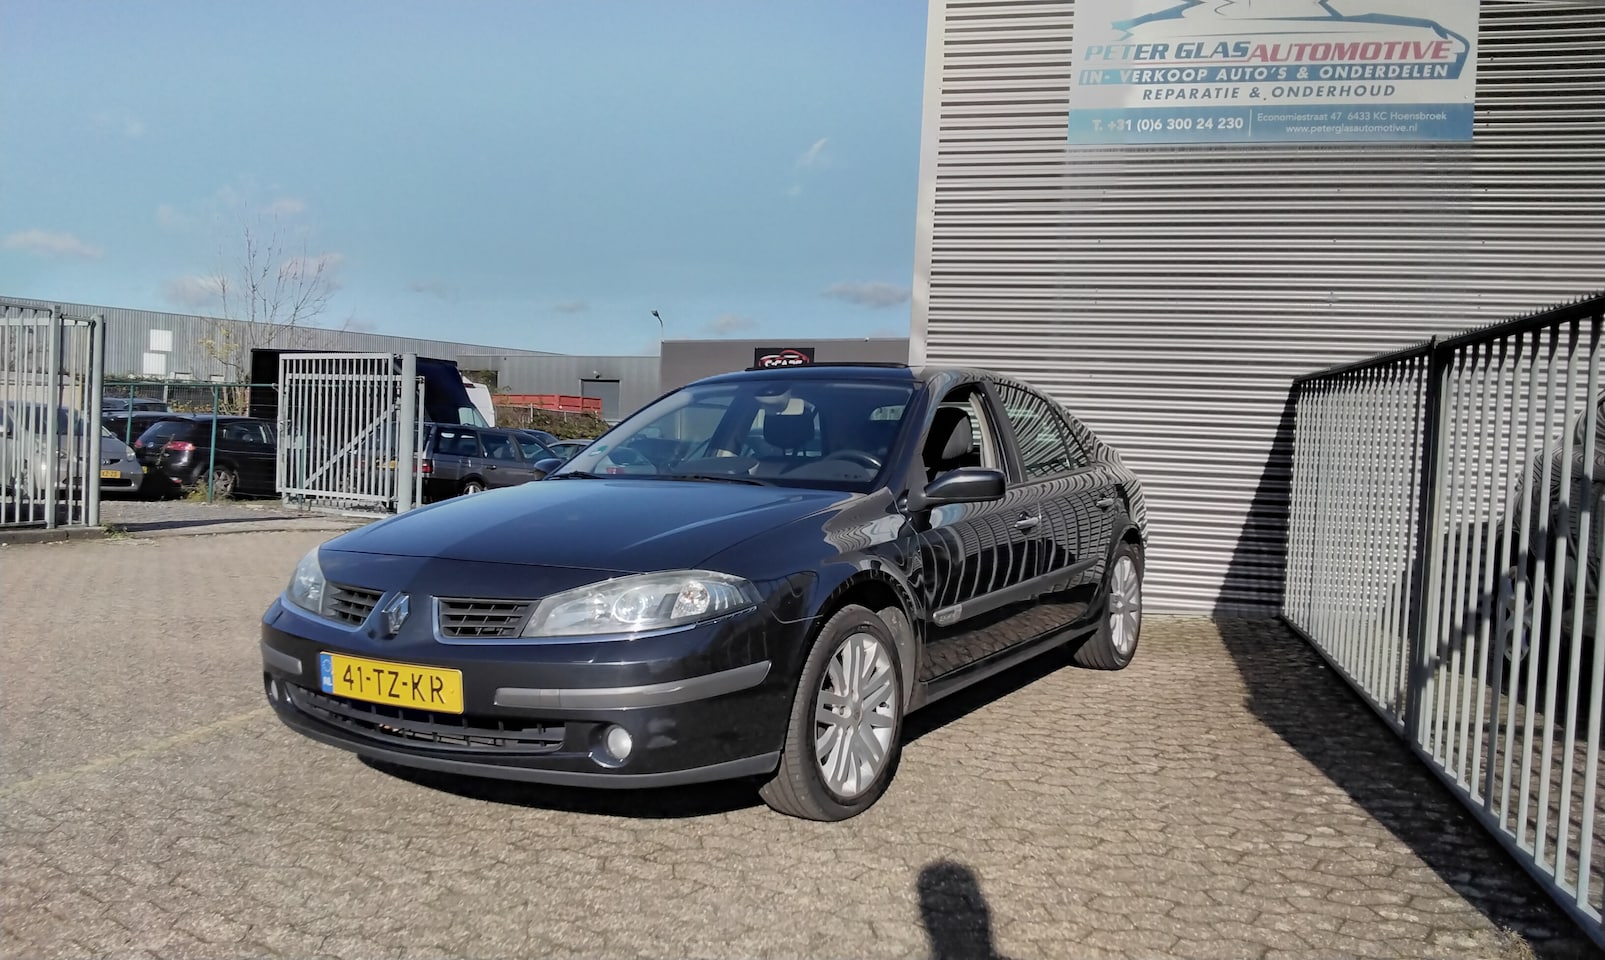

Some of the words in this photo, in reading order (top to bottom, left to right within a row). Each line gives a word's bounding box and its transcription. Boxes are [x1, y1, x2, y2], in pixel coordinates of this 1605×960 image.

[1120, 69, 1207, 83] VERKOOP
[1216, 67, 1287, 81] AUTO'S
[1296, 66, 1309, 80] &
[1319, 64, 1449, 79] ONDERDELEN
[1142, 87, 1240, 101] REPARATIE
[1249, 86, 1260, 98] &
[1271, 85, 1396, 98] ONDERHOUD
[1257, 112, 1328, 122] Economiestraat
[1330, 112, 1342, 120] 47
[1347, 111, 1370, 121] 6433
[1373, 111, 1387, 120] KC
[1390, 111, 1447, 121] Hoensbroek
[1136, 119, 1163, 132] (0)6
[1166, 118, 1192, 130] 300
[1196, 118, 1213, 130] 24
[1217, 117, 1244, 129] 230
[1286, 123, 1418, 134] www.peterglasautomotive.nl
[343, 664, 445, 704] 41-TZ-KR
